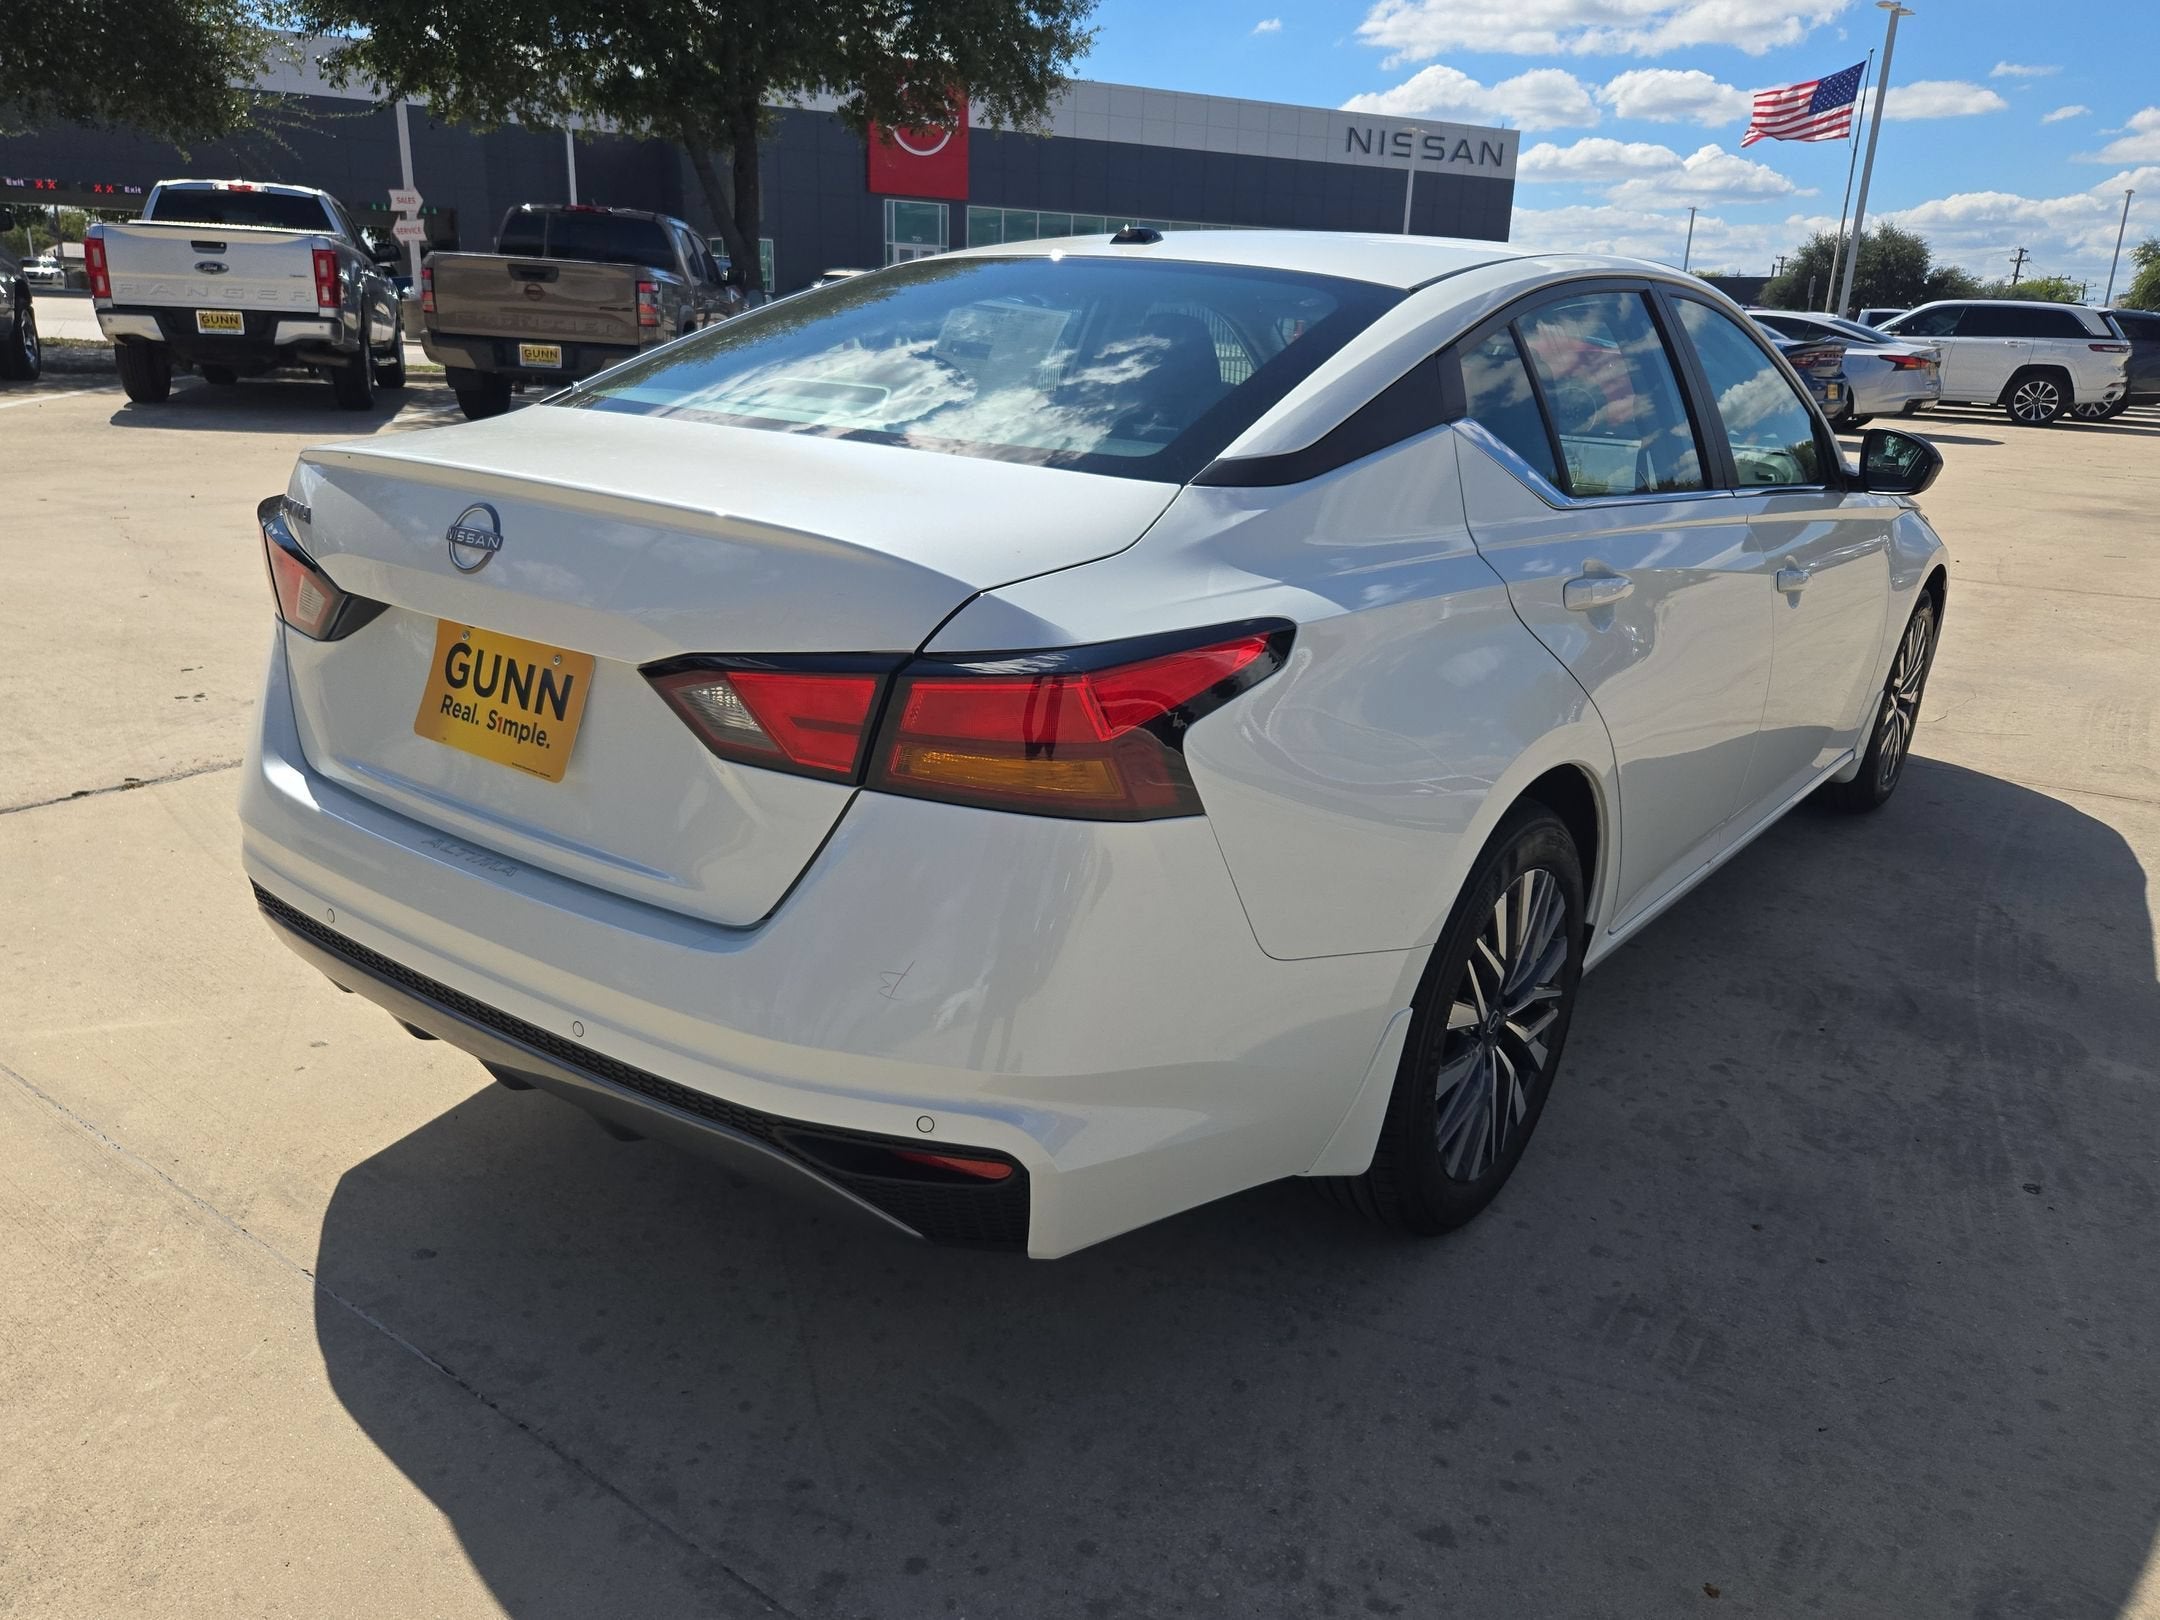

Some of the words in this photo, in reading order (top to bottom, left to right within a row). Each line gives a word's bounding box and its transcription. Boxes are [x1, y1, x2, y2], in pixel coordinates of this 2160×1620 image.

[1346, 127, 1504, 167] NISSAN
[6, 178, 24, 187] Exit
[125, 185, 142, 194] Exit
[396, 196, 417, 204] SALES
[118, 283, 311, 302] RANGER
[201, 315, 239, 324] GUNN
[524, 349, 558, 358] GUNN
[448, 526, 500, 549] NISSAN
[444, 642, 574, 722] GUNN
[440, 694, 480, 726] Real.
[486, 709, 550, 749] Simple.
